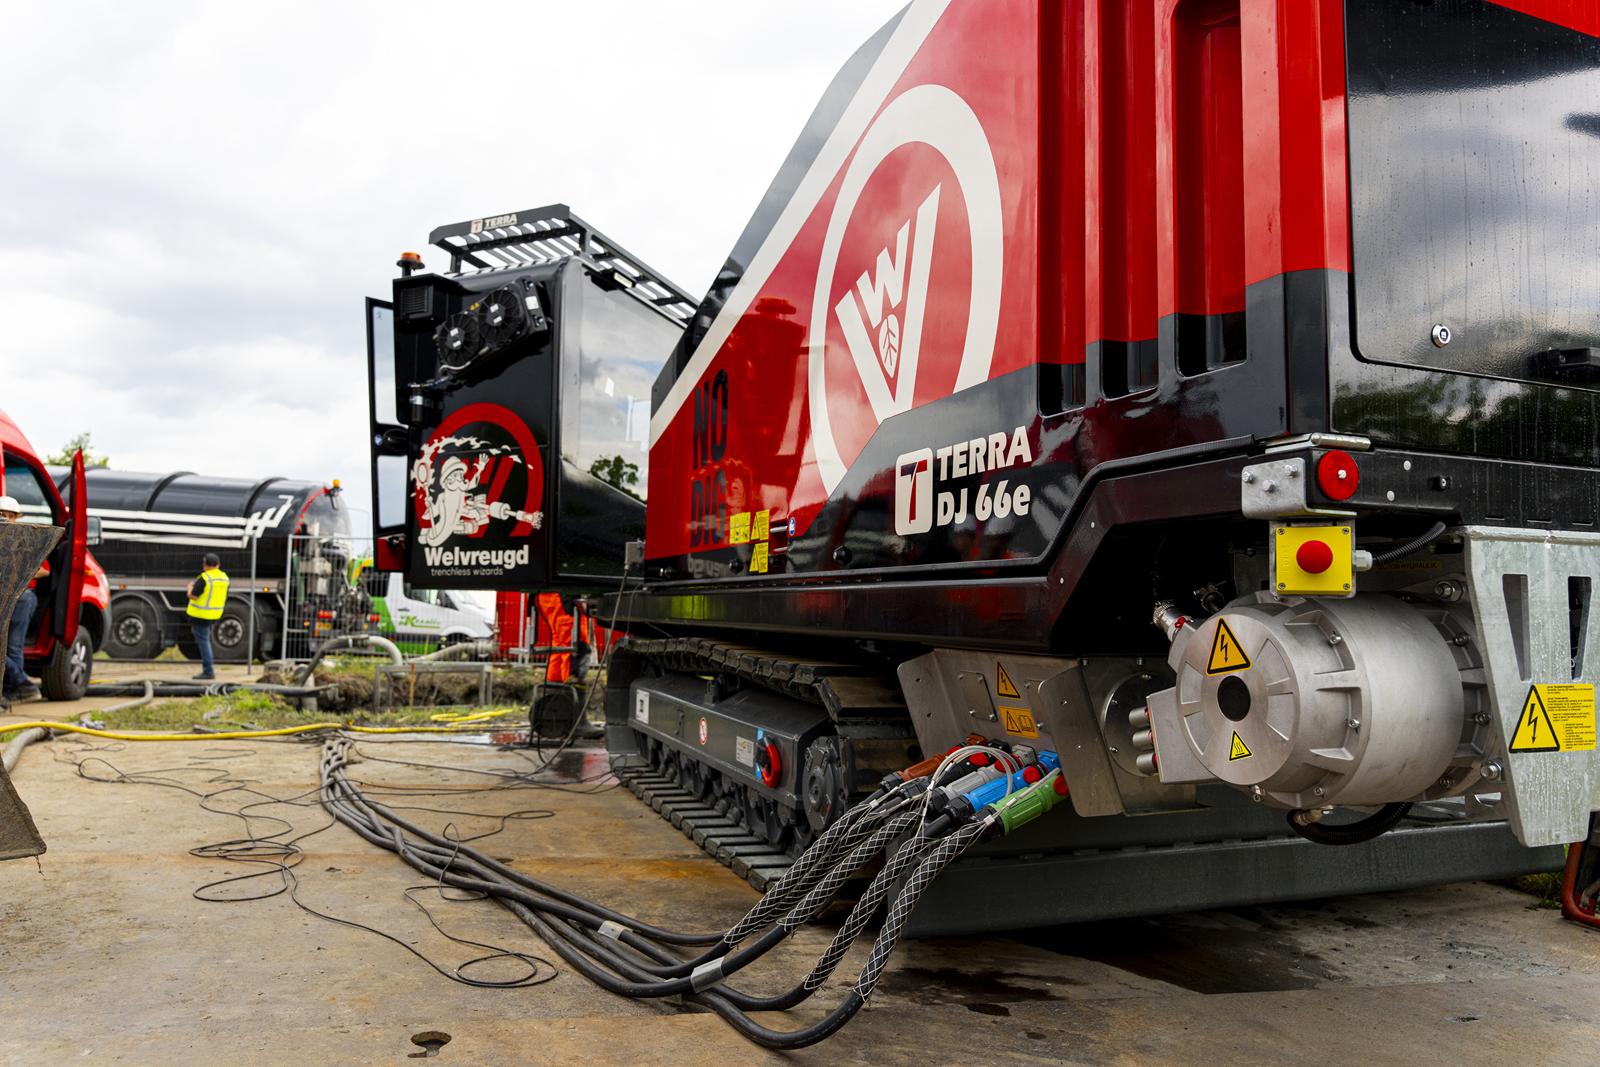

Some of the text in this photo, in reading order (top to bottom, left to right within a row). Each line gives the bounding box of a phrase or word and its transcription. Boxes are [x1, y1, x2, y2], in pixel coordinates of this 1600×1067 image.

[484, 213, 518, 230] TERRA
[693, 368, 728, 470] NO
[936, 425, 1032, 482] TERRA
[690, 469, 727, 548] DIG
[936, 479, 1031, 527] DJ 66e
[424, 544, 529, 569] Welvreugd
[431, 566, 503, 576] trenchless wizards
